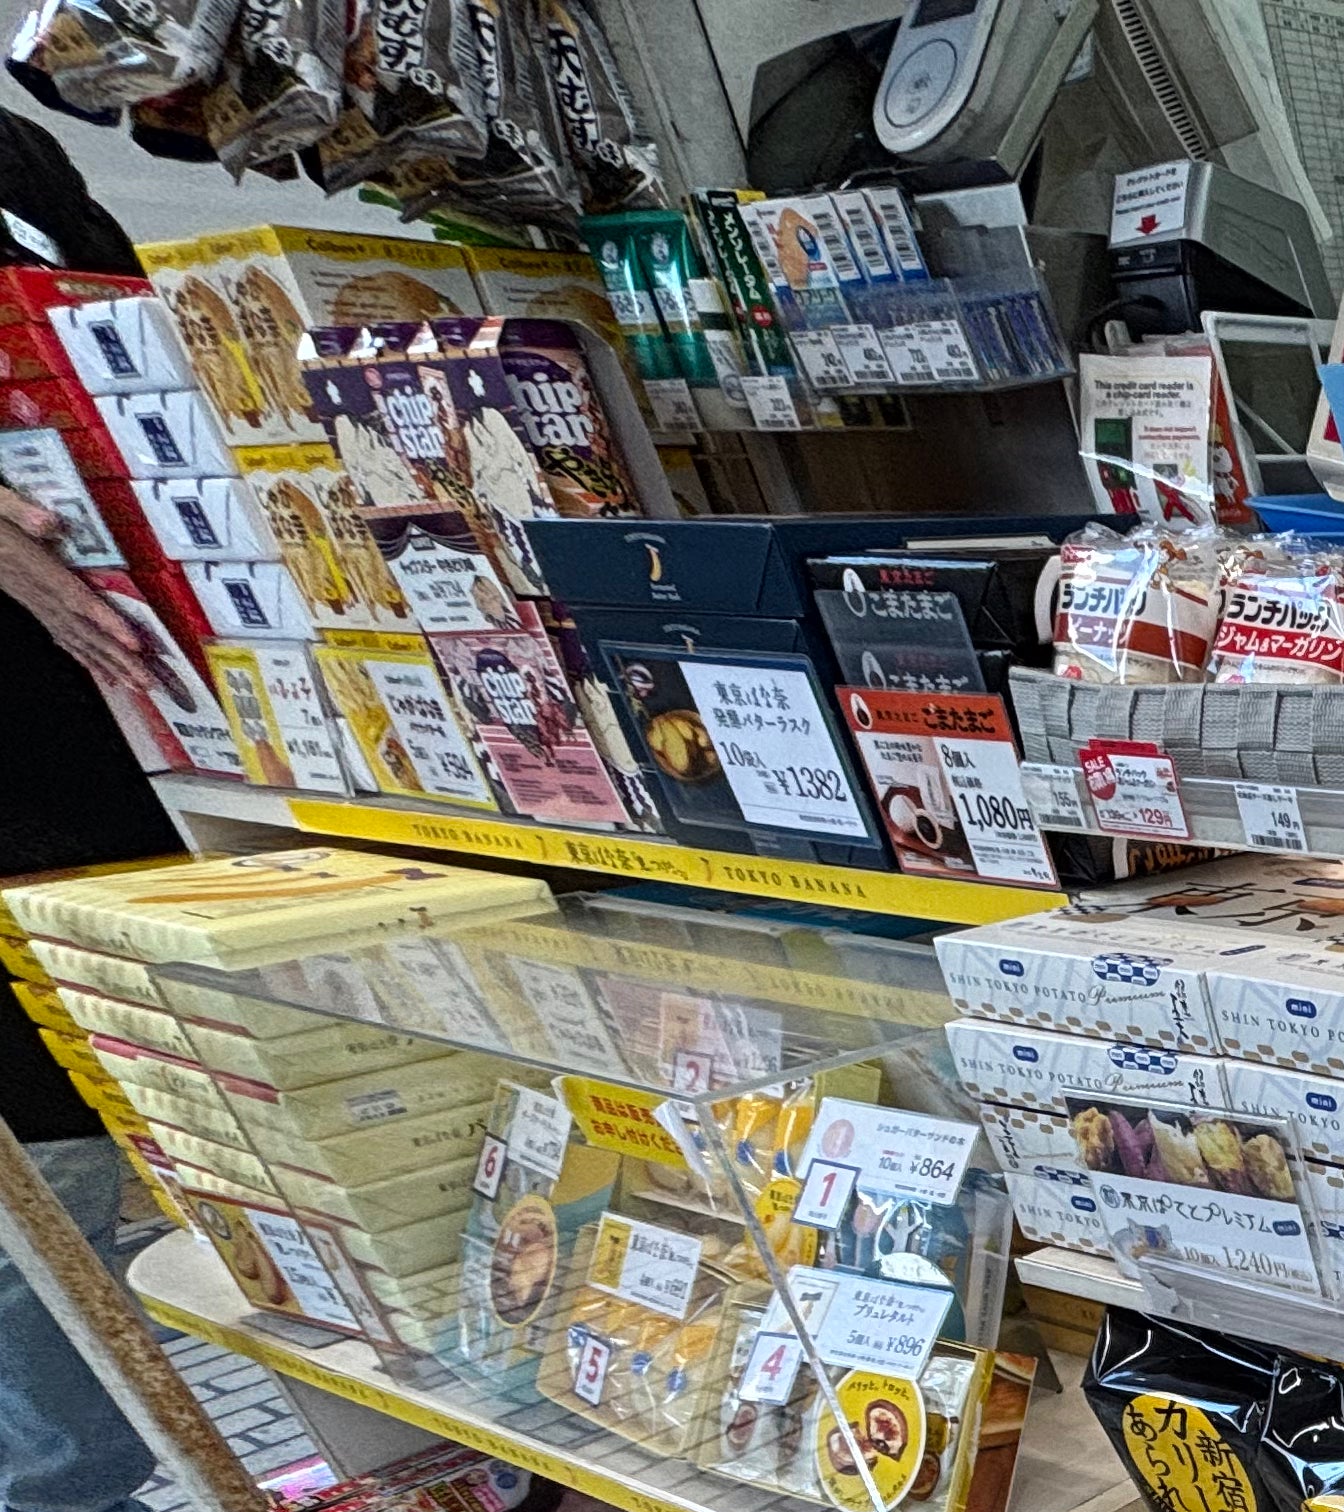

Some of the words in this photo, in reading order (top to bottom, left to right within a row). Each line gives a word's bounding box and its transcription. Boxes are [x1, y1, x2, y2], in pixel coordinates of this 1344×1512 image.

[1094, 380, 1114, 390] This
[1116, 380, 1138, 391] credit
[1139, 380, 1157, 391] card
[1159, 380, 1185, 392] reader
[772, 766, 848, 803] ¥1382
[958, 792, 1035, 832] 1,080円
[722, 866, 782, 888] TOKYO
[791, 876, 867, 899] BANANA
[949, 971, 979, 988] SHIN
[982, 975, 1029, 996] TOKYO
[1033, 983, 1088, 1003] POTATO
[1220, 1009, 1261, 1026] SHIN
[1266, 1016, 1322, 1040] TOKYO
[1284, 1108, 1341, 1133] TOKYO
[909, 1157, 956, 1182] ¥864
[819, 1171, 837, 1208] 1
[760, 1344, 788, 1382] 4
